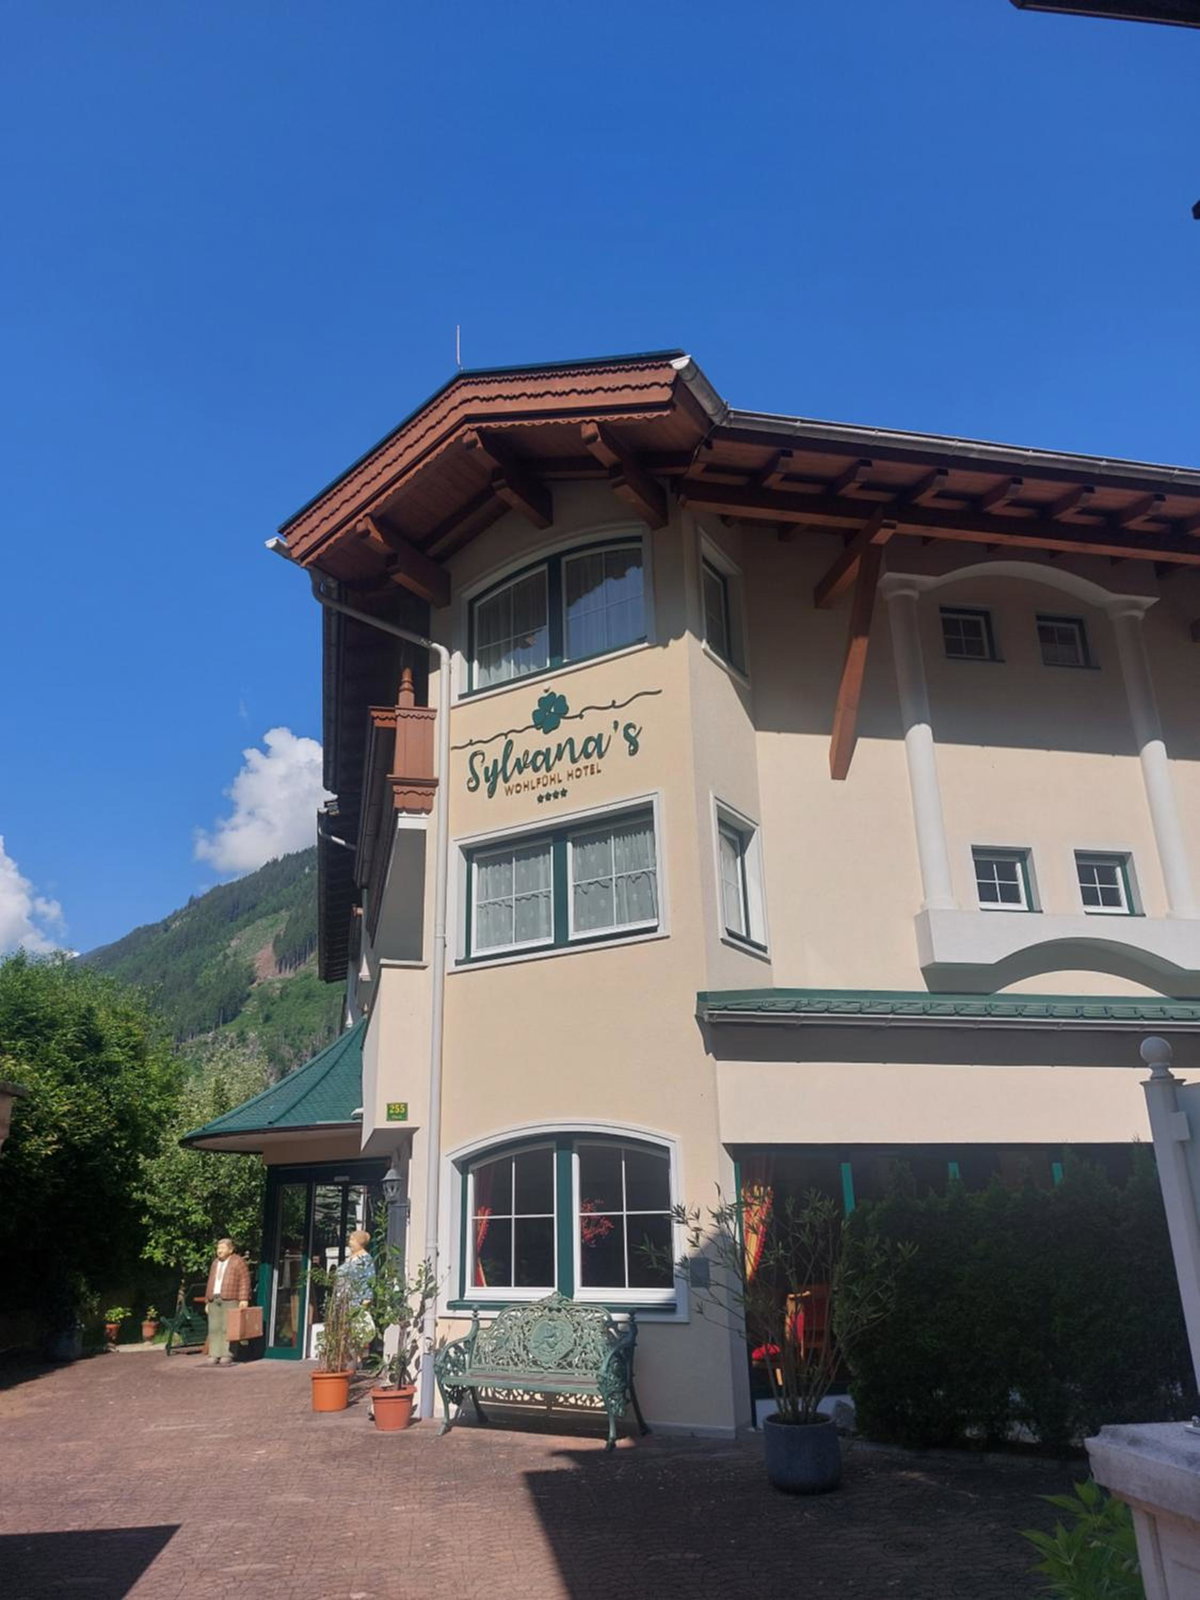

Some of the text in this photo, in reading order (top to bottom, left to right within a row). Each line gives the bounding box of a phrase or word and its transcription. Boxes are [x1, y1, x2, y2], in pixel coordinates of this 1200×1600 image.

[466, 720, 642, 799] Sylvana's
[567, 762, 602, 781] HOTEL
[389, 1104, 405, 1114] 255
